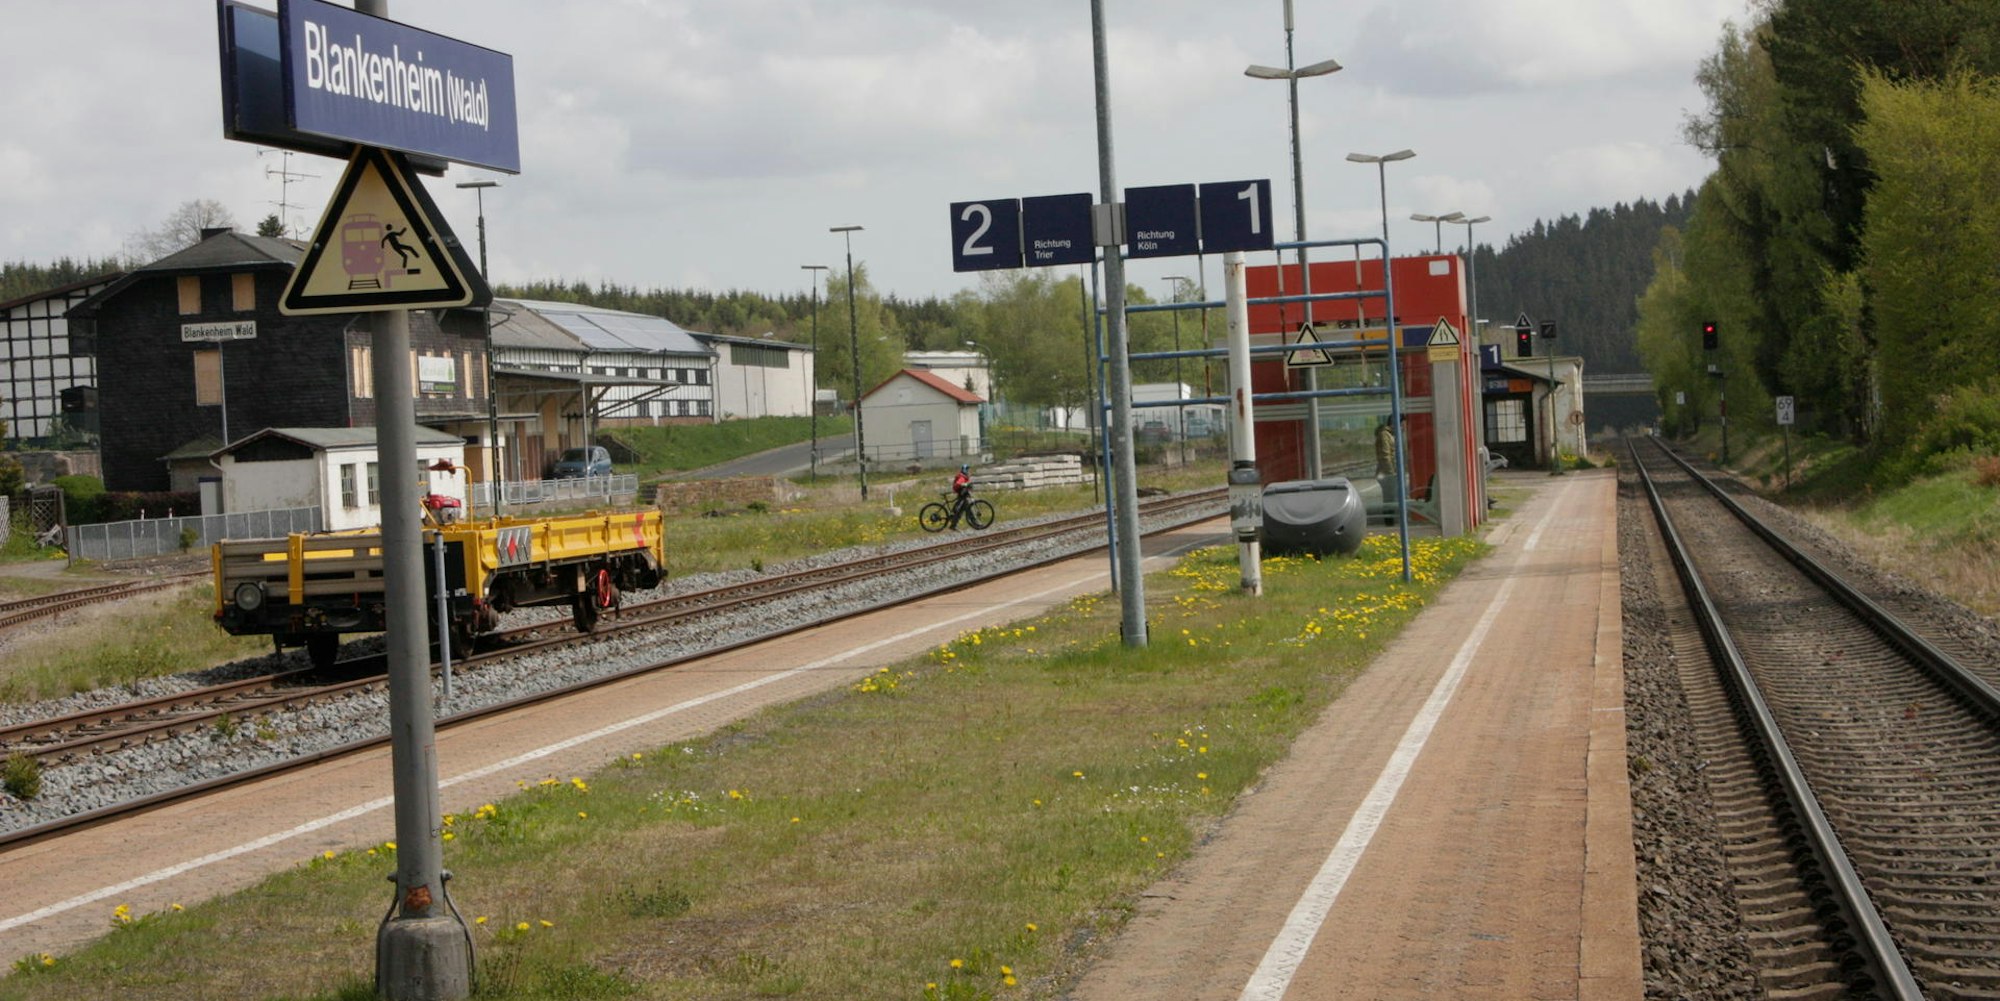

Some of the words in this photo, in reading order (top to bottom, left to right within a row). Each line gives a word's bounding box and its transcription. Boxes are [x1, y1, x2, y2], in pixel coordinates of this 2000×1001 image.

[304, 20, 444, 117] Blankenheim
[447, 69, 489, 132] (Wald)
[1237, 182, 1260, 234] 1
[960, 203, 993, 256] 2
[1137, 229, 1175, 240] Richtung
[1034, 239, 1071, 249] Richtung
[1137, 241, 1158, 250] Köln
[1035, 250, 1054, 259] Trier
[184, 325, 233, 339] Blankenheim
[235, 323, 253, 336] Wald
[1489, 345, 1498, 364] 1
[1778, 398, 1792, 410] 69
[1782, 410, 1789, 421] 4
